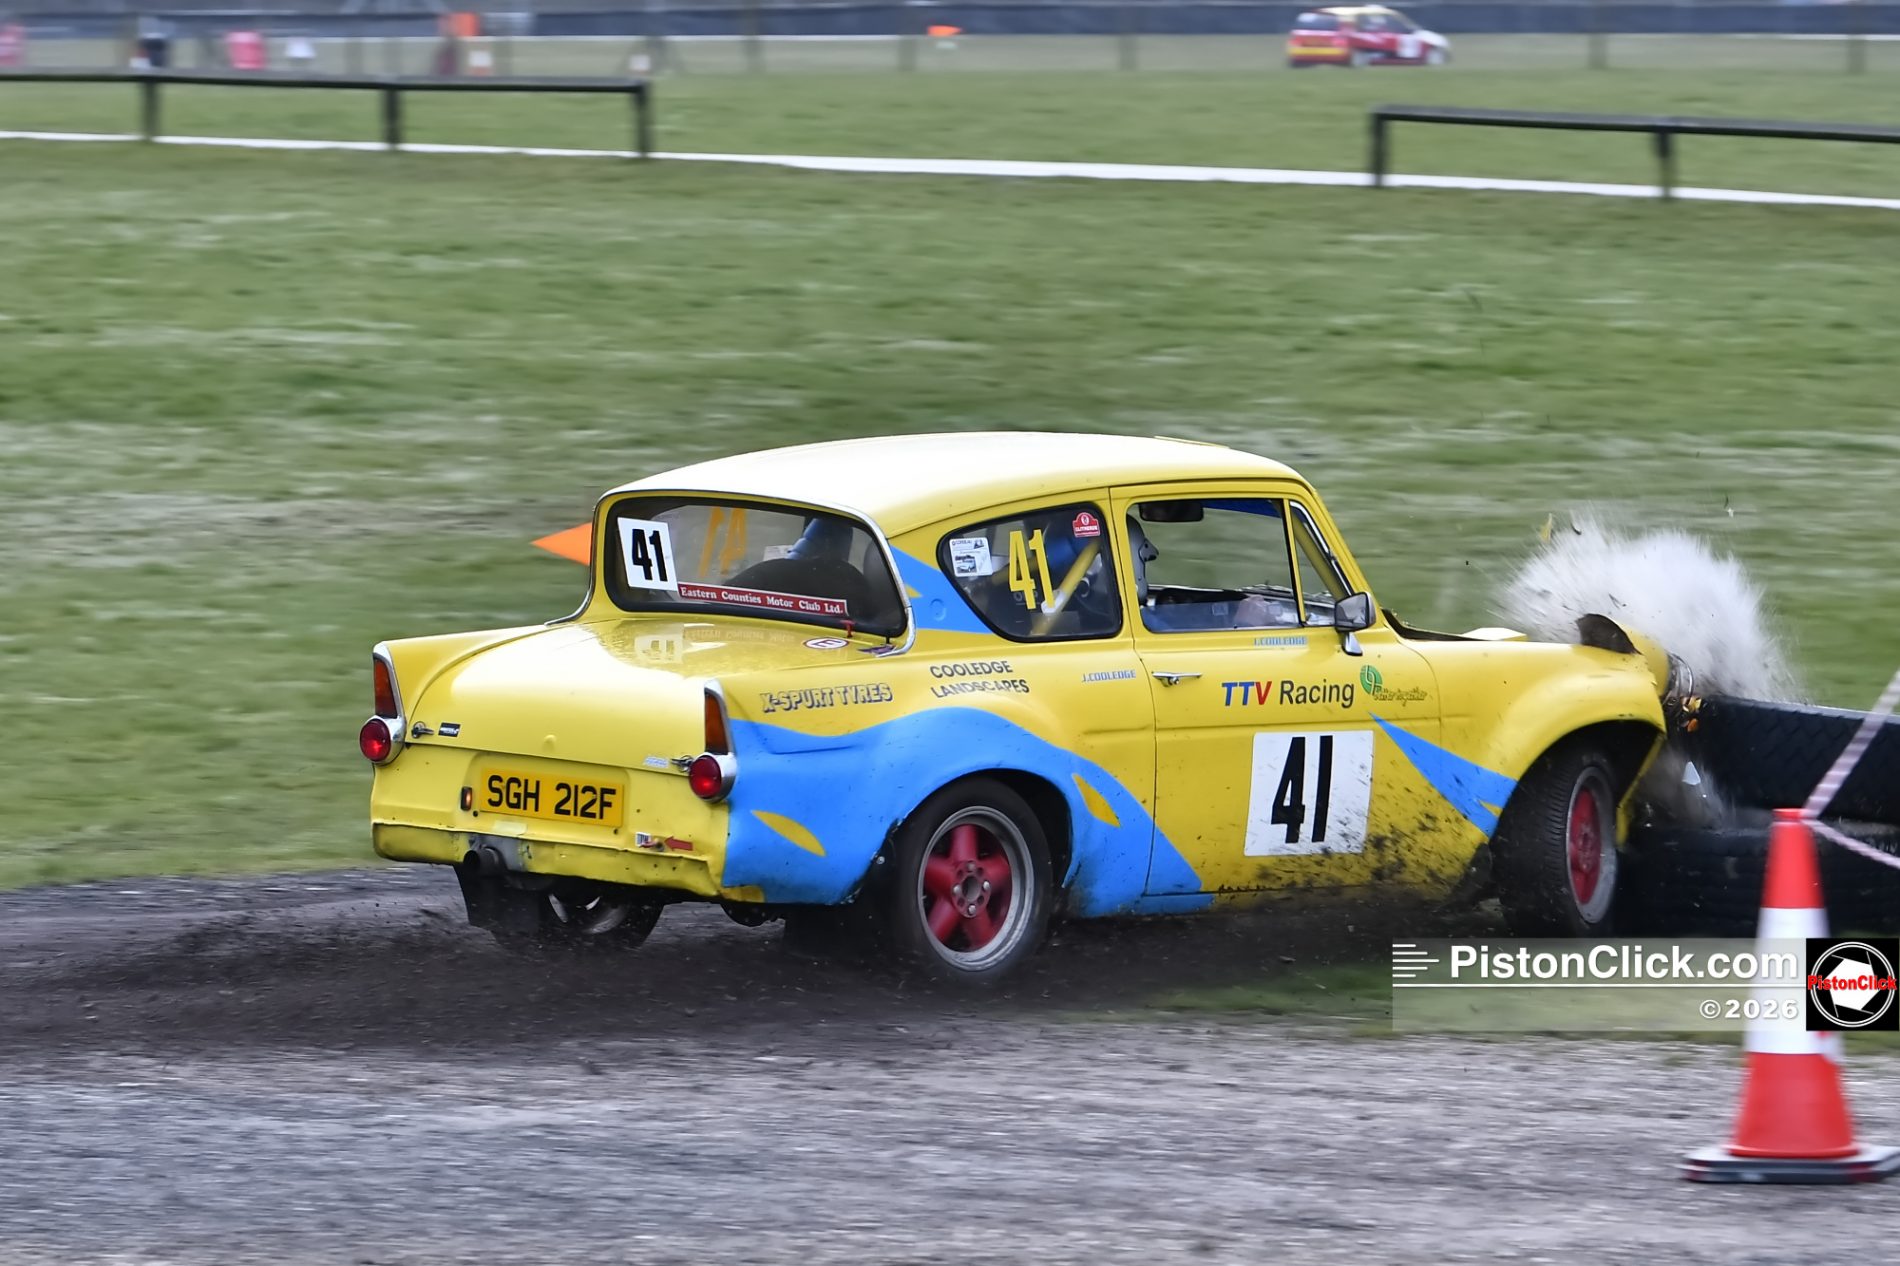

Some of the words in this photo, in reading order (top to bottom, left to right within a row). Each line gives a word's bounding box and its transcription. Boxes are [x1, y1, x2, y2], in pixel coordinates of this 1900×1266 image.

[631, 528, 669, 582] 41
[1009, 529, 1055, 610] 41
[681, 587, 717, 599] Eastern
[721, 591, 761, 604] Counties
[766, 596, 793, 608] Motor
[799, 600, 820, 611] Club
[824, 603, 844, 613] Ltd.
[930, 660, 1014, 679] COOLEDGE
[1081, 669, 1136, 682] J.COOLEDGE
[760, 686, 834, 713] X-SPURT
[835, 682, 893, 706] TYRES
[930, 679, 1030, 698] LANDSCAPES
[1221, 681, 1272, 706] TTV
[1280, 679, 1355, 708] Racing
[487, 774, 540, 812] SGH
[554, 782, 617, 820] 212F
[1271, 735, 1333, 844] 41
